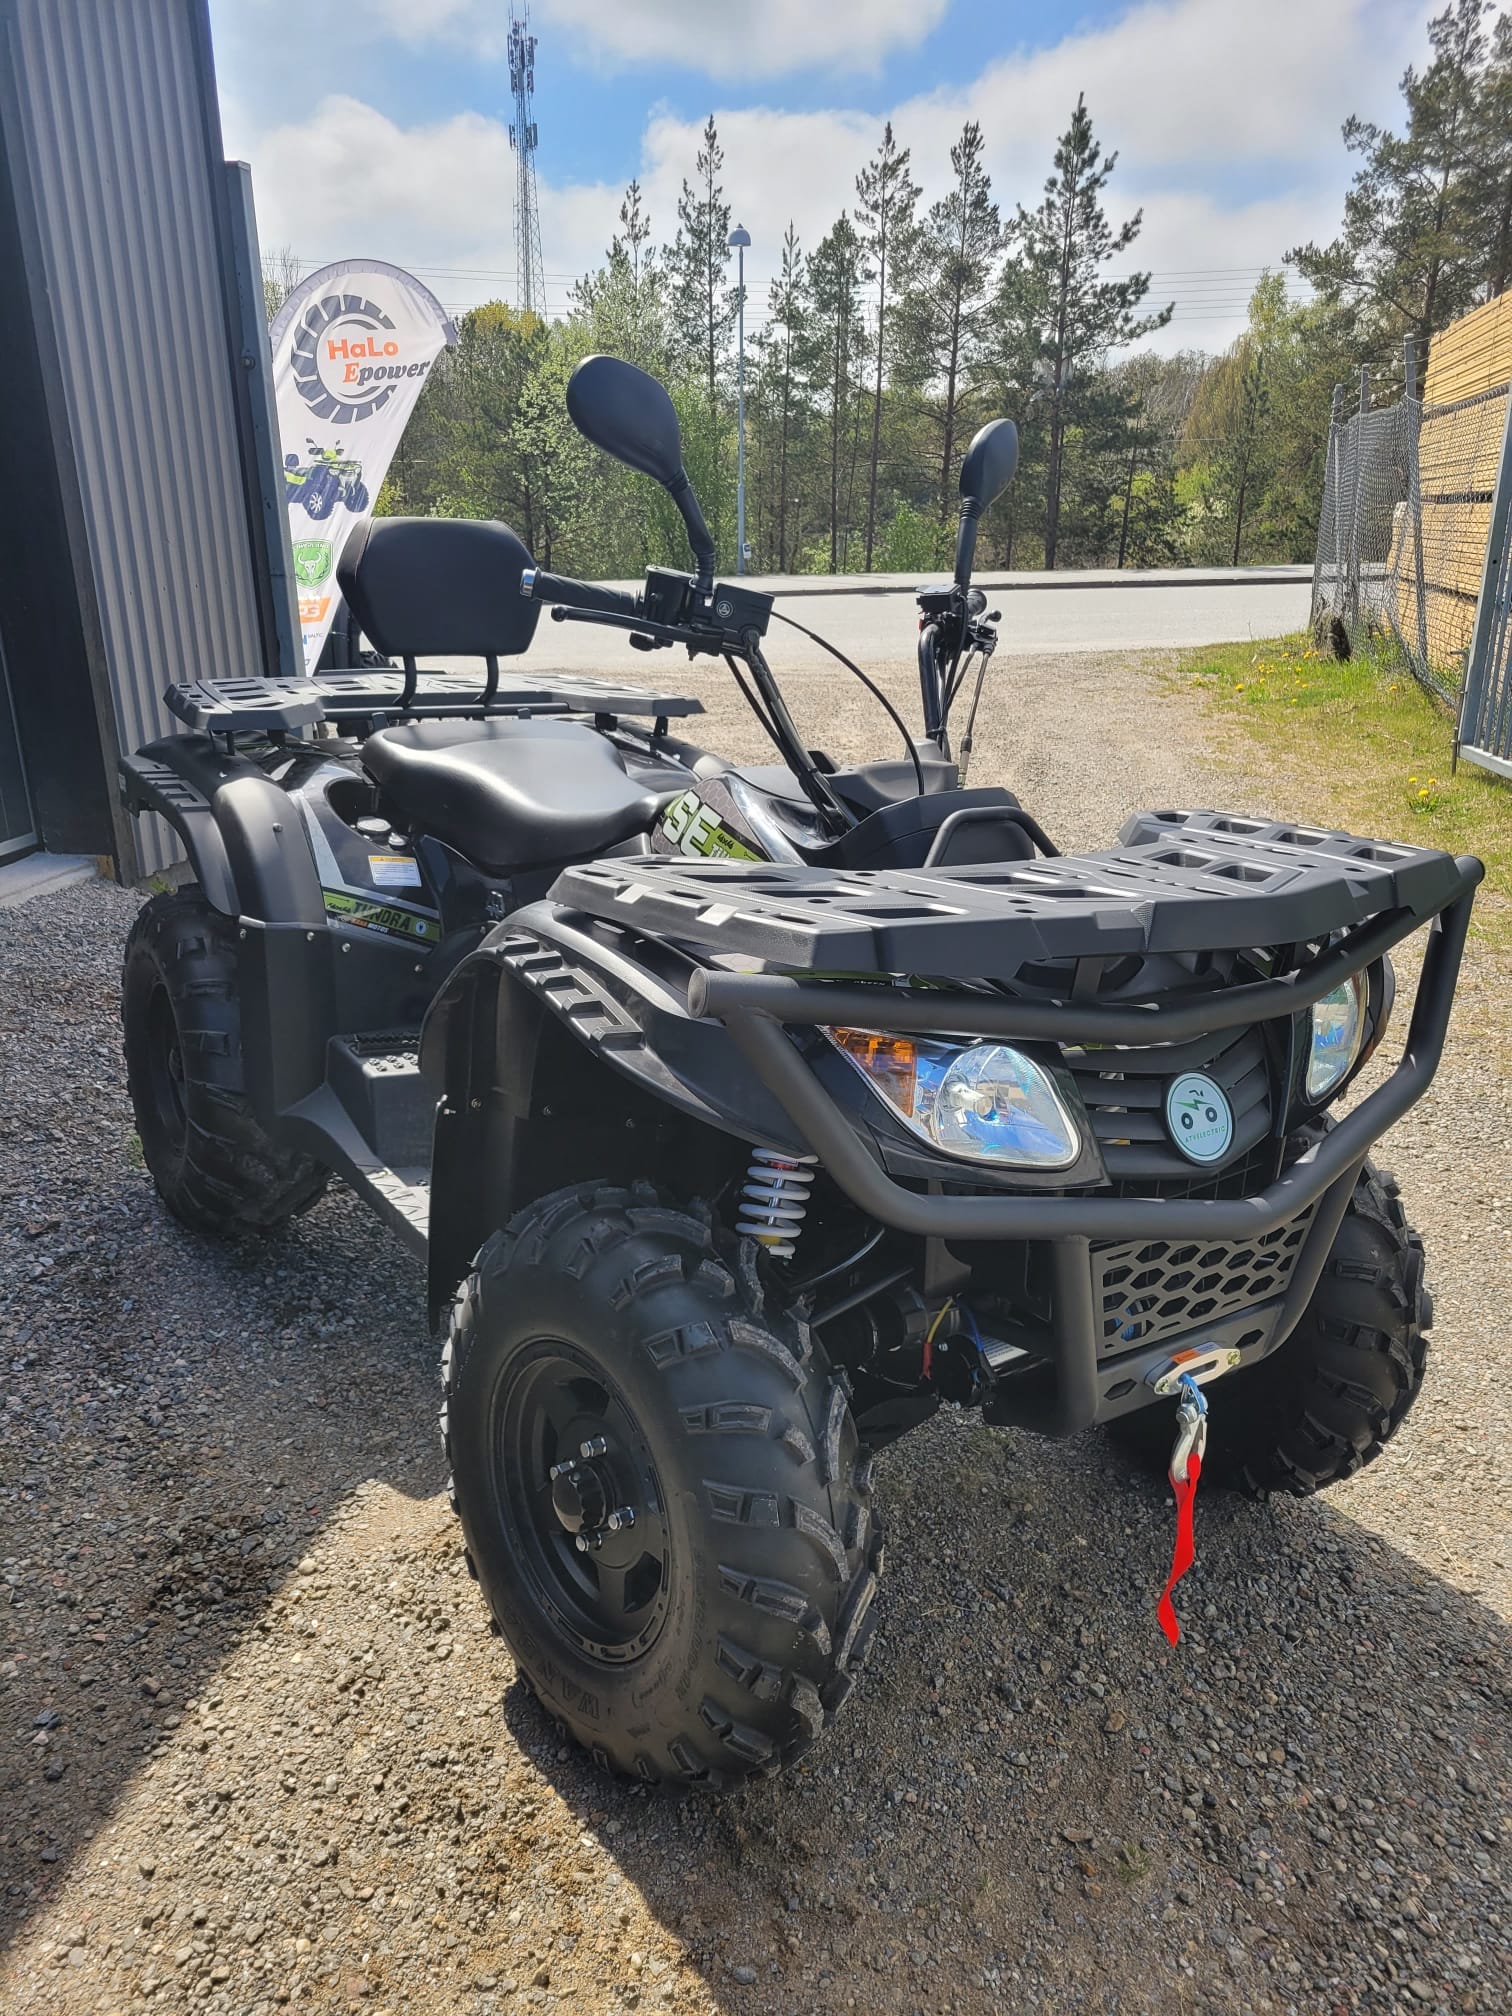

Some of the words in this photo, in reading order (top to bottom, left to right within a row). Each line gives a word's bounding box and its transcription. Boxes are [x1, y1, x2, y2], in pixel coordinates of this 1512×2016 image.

[327, 337, 399, 360] HaLo
[342, 359, 430, 386] Epower
[354, 901, 411, 931] TUNDRA
